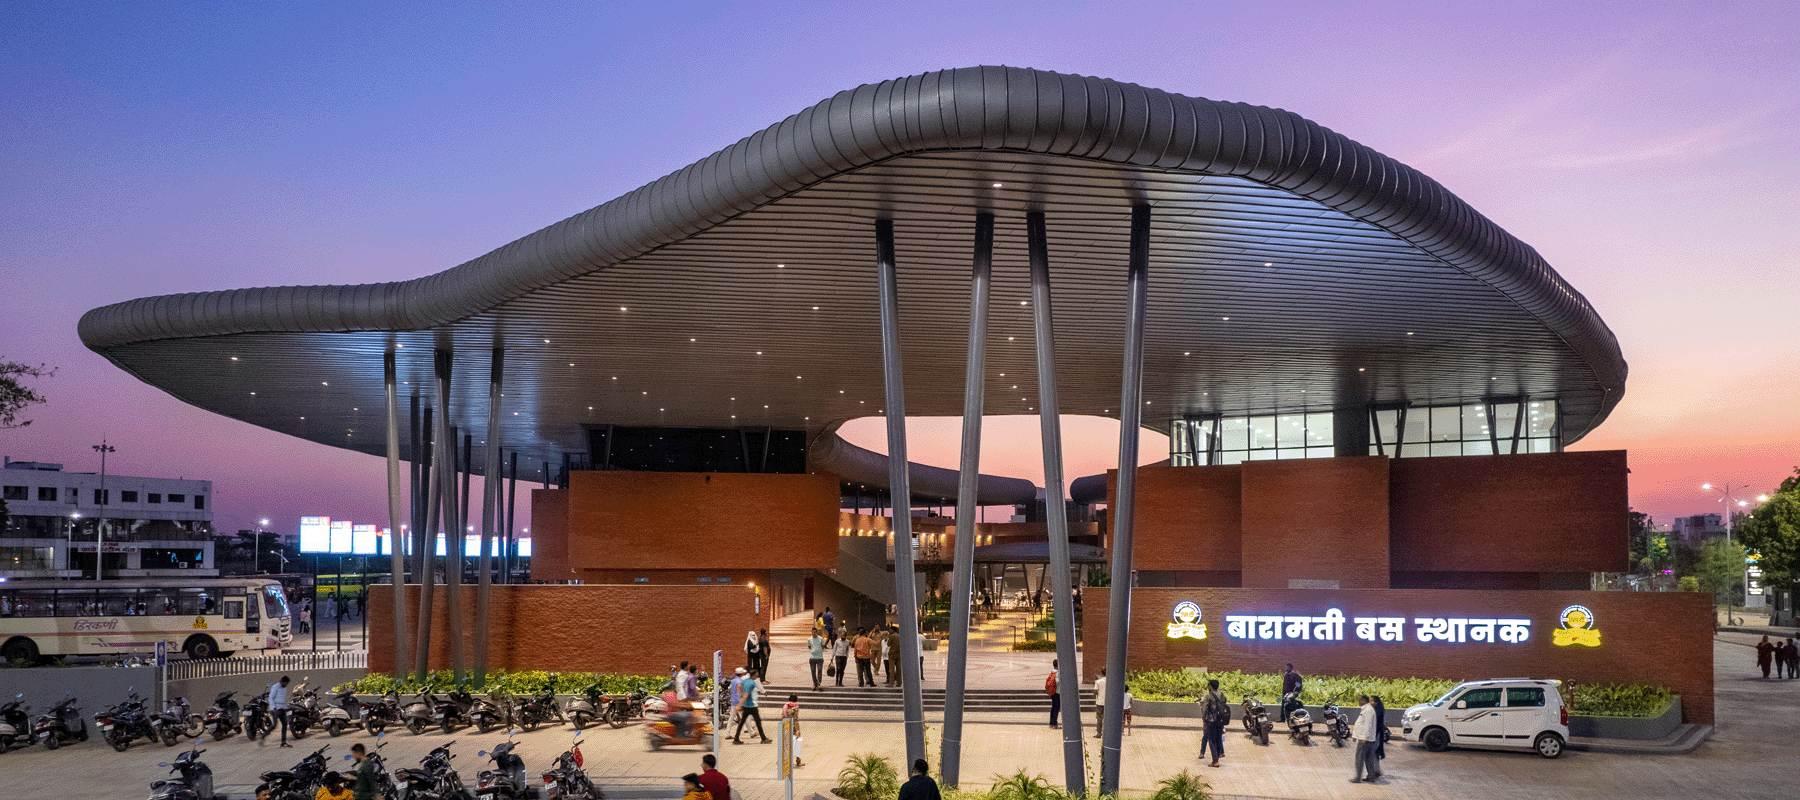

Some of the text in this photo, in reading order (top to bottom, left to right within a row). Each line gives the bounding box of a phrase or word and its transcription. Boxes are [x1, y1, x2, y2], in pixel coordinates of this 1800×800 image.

[1225, 608, 1346, 641] बारामती
[1354, 617, 1406, 641] बस
[1415, 617, 1531, 643] स्थानक
